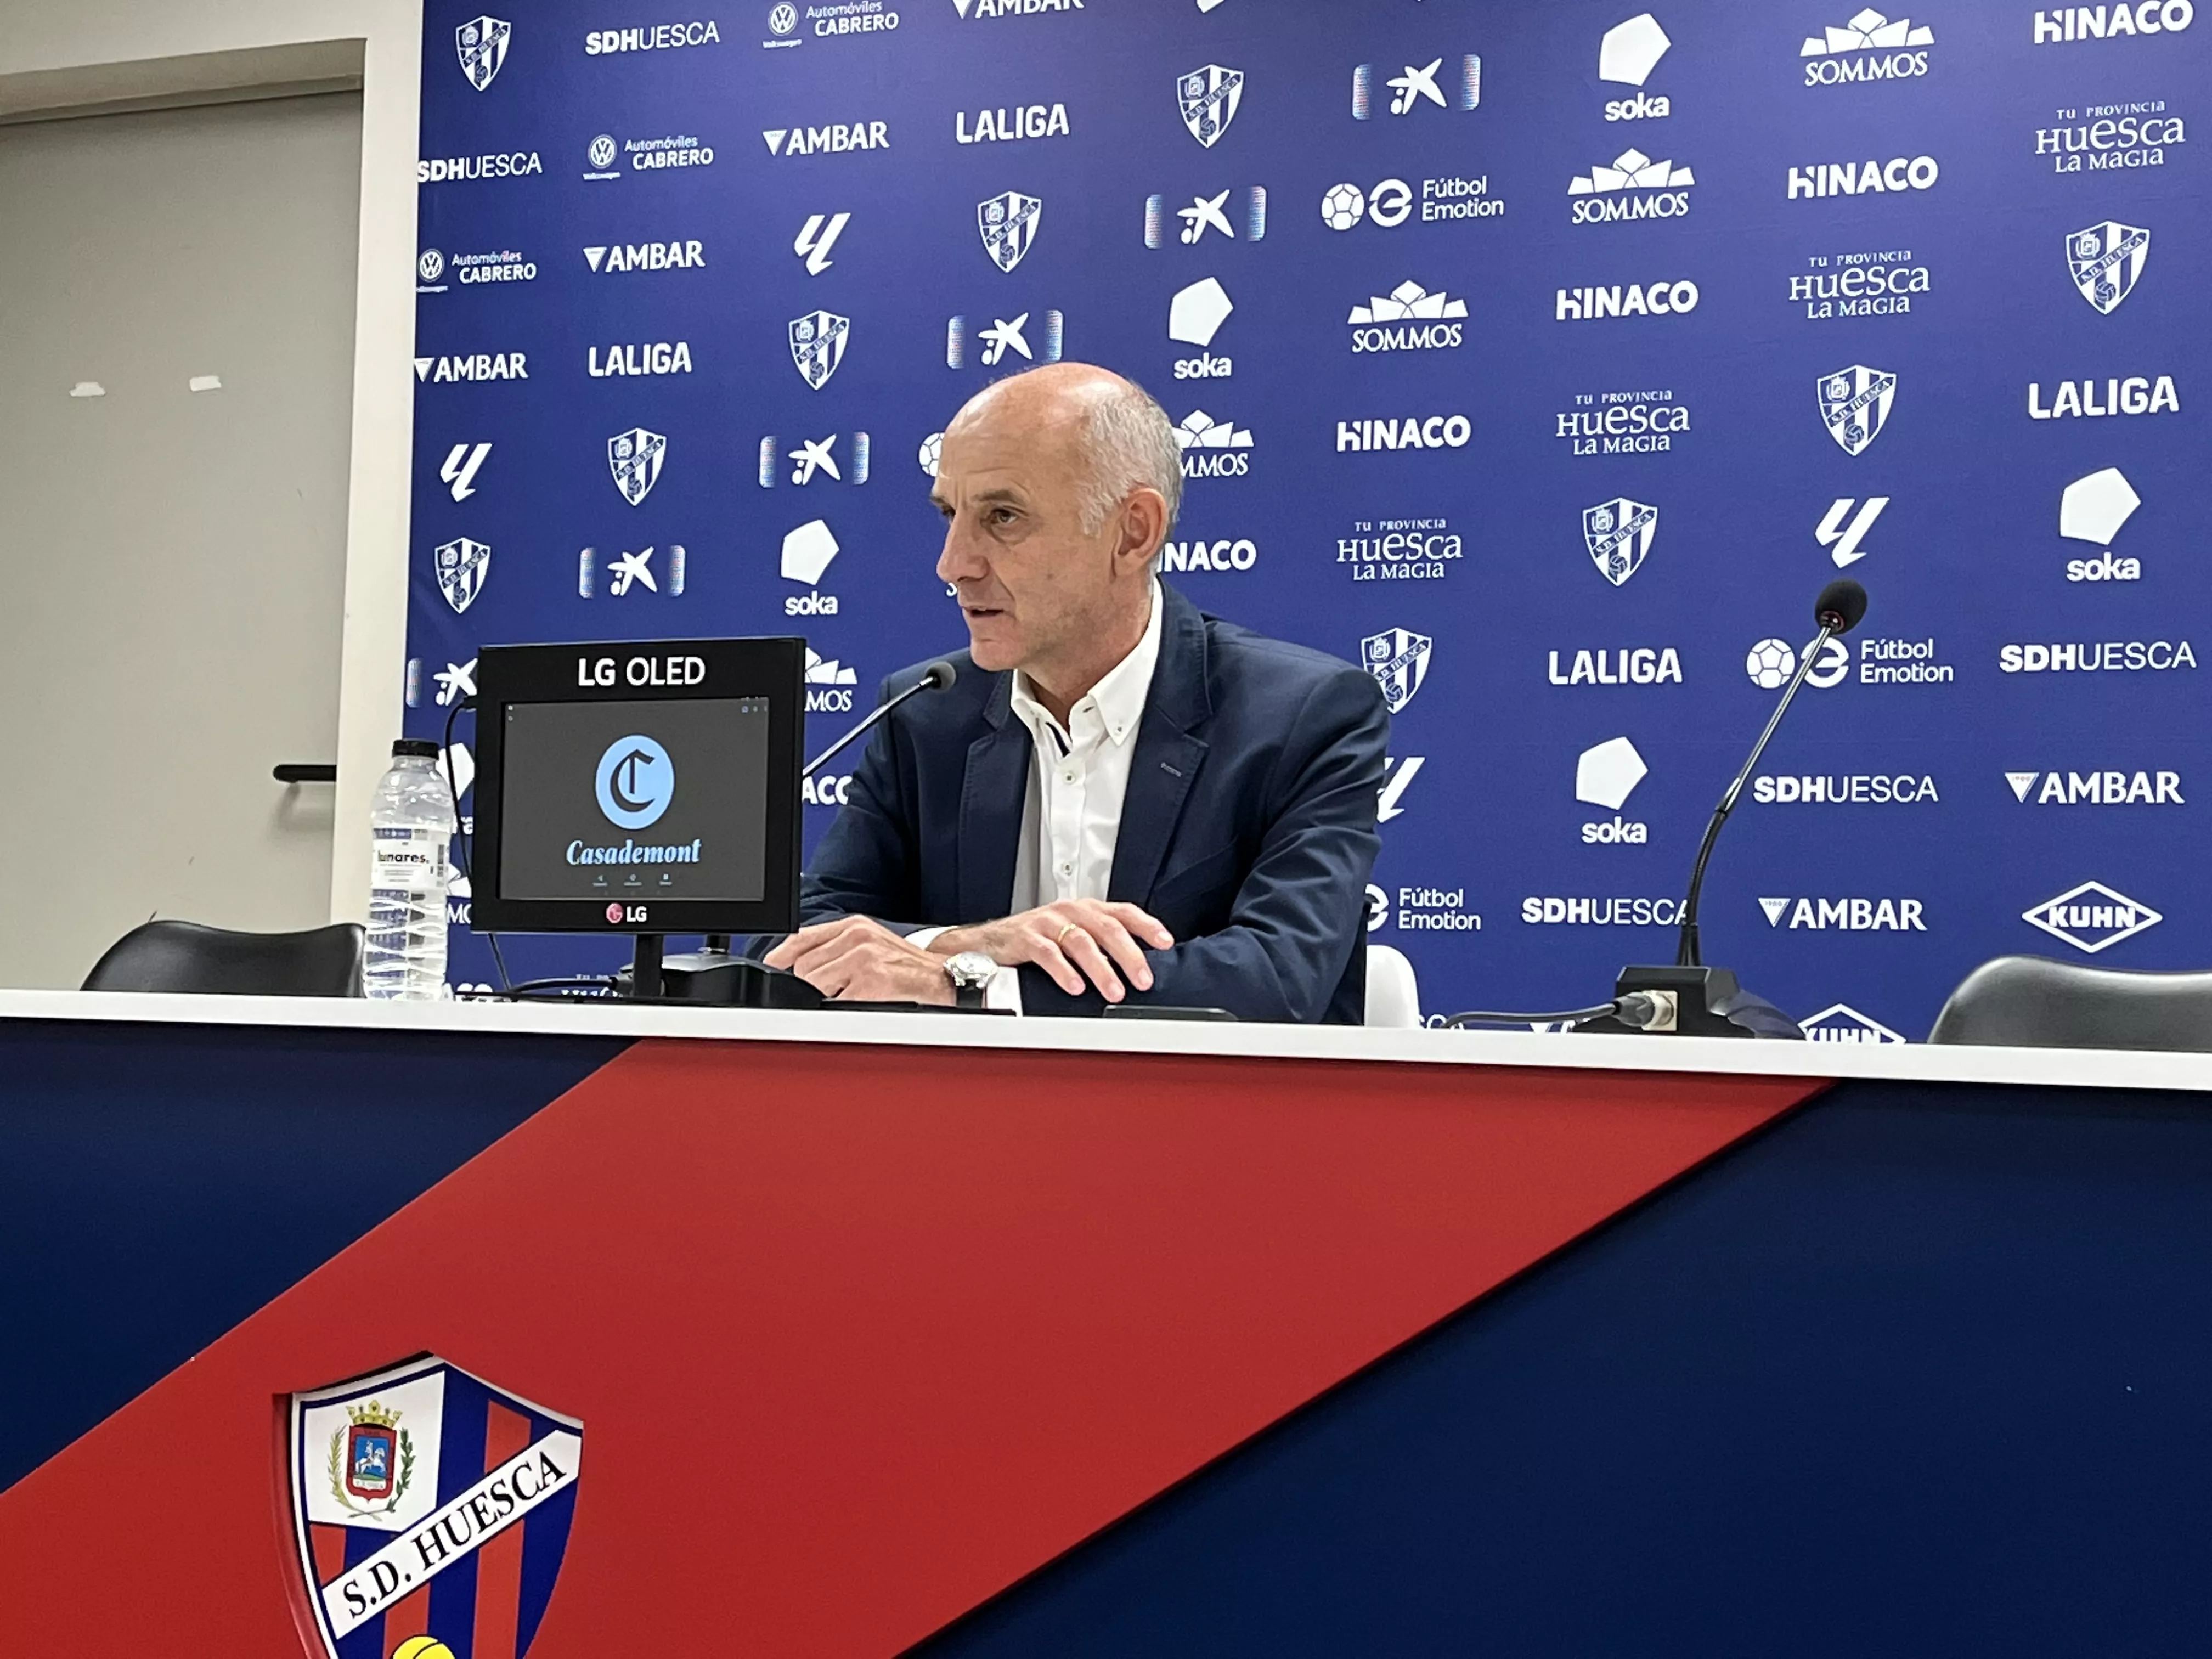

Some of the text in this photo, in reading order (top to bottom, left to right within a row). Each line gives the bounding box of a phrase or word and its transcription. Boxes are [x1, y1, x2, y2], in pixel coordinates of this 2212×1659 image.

[585, 21, 720, 55] SDHUESCA
[815, 12, 899, 37] CABRERO
[1804, 51, 1928, 86] SOMMOS
[1604, 92, 1669, 121] soka
[956, 103, 1069, 144] LALIGA
[786, 121, 890, 156] AMBAR
[417, 152, 543, 182] SDHUESCA
[633, 148, 714, 170] CABRERO
[1423, 175, 1487, 199] Fútbol
[1421, 197, 1504, 221] Emotion
[1572, 191, 1689, 224] SOMMOS
[605, 240, 706, 273] AMBAR
[459, 262, 537, 284] CABRERO
[1352, 323, 1462, 352] SOMMOS
[433, 353, 528, 382] AMBAR
[589, 342, 692, 377] LALIGA
[1173, 352, 1232, 379] soka
[2029, 376, 2179, 419] LALIGA
[2067, 551, 2140, 582] soka
[785, 590, 838, 616] soka
[1861, 638, 1933, 660] Fútbol
[1999, 641, 2197, 672] SDHUESCA
[578, 657, 705, 686] LG OLED
[1549, 648, 1682, 685] LALIGA
[1860, 662, 1953, 683] Emotion
[1753, 775, 1939, 803] SDHUESCA
[2038, 771, 2185, 804] AMBAR
[1582, 816, 1647, 843] soka
[567, 839, 702, 865] Casademont
[1400, 887, 1464, 907] Fútbol
[627, 906, 647, 922] LG
[1398, 910, 1481, 930] Emotion
[1789, 898, 1927, 930] AMBAR
[2048, 906, 2136, 928] KUHN
[343, 1451, 567, 1619] S.D. HUESCA
